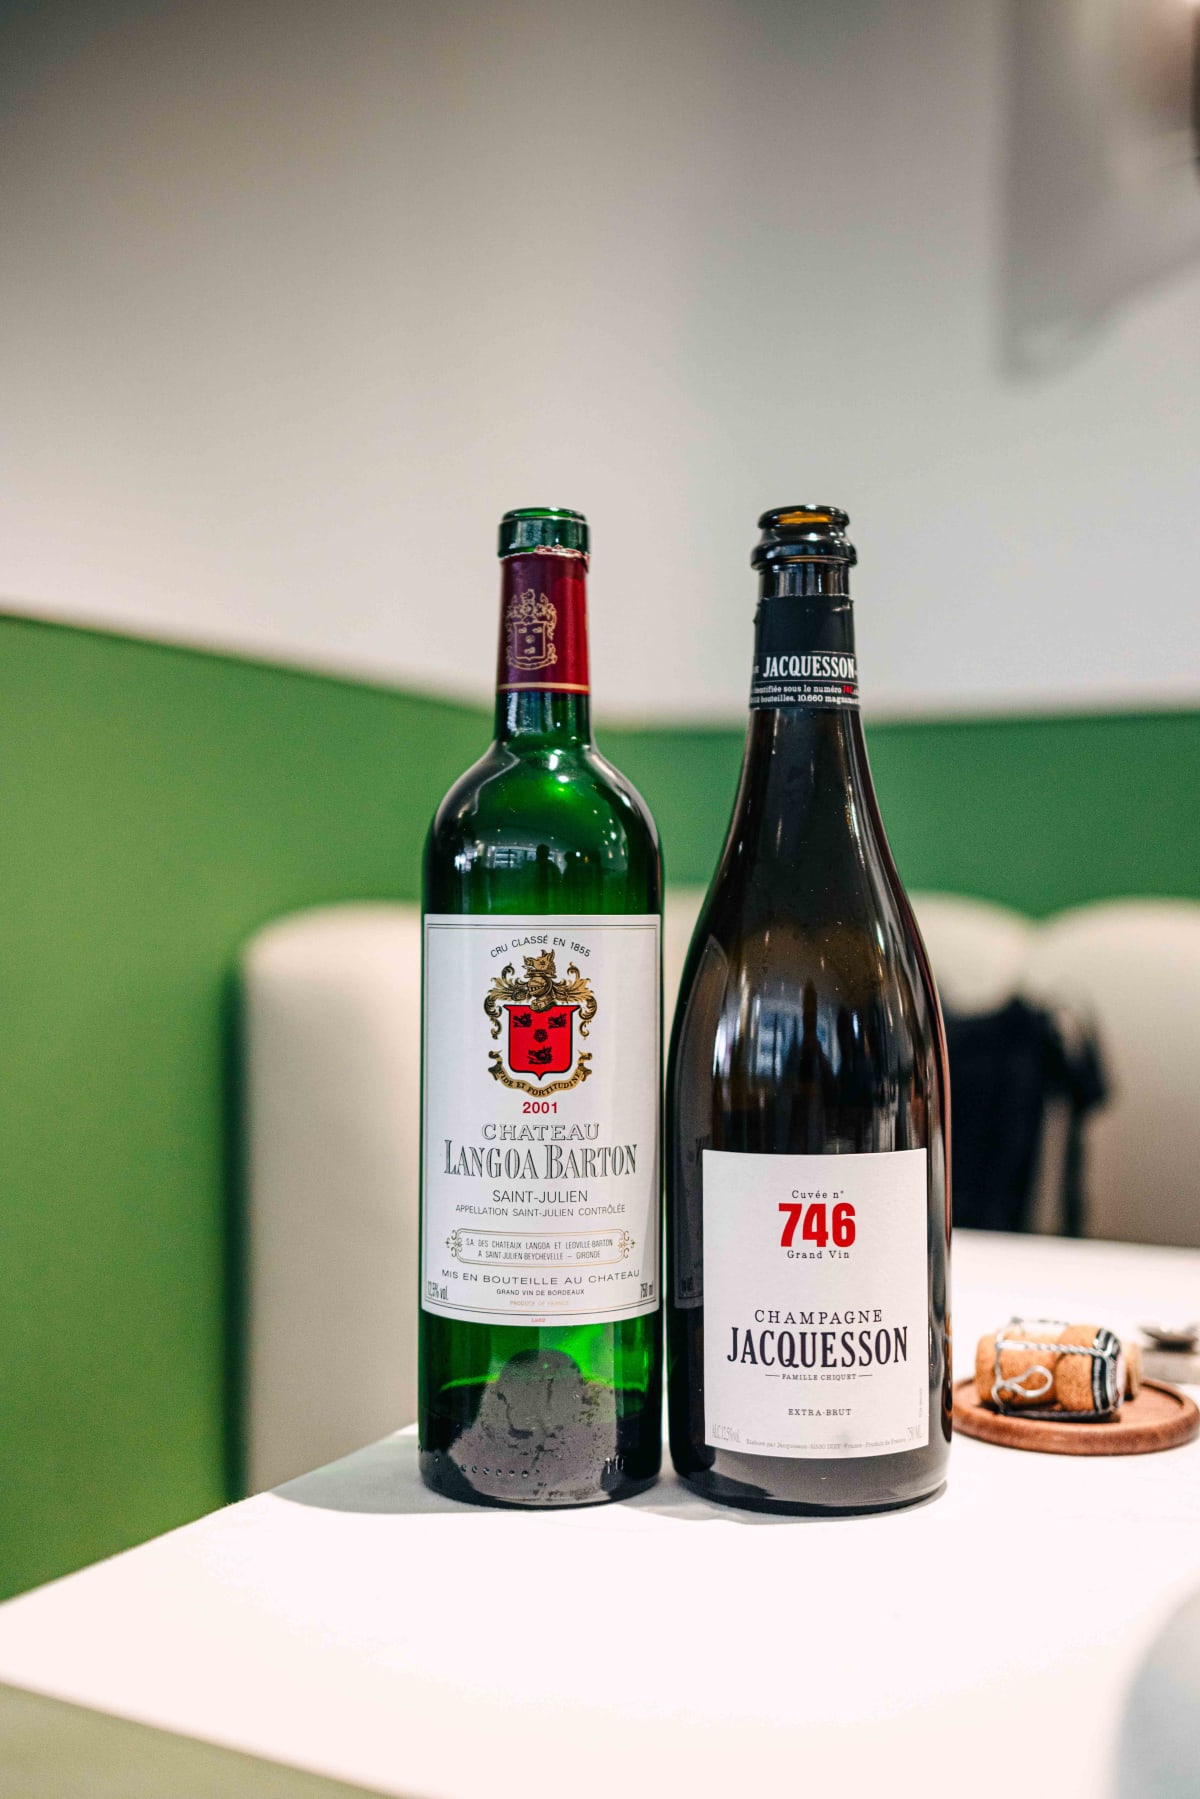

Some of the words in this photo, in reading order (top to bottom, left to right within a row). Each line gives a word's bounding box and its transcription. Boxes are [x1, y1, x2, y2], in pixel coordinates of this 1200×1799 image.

[763, 656, 855, 678] JACQUESSON
[804, 684, 811, 692] le
[814, 685, 842, 693] numéro
[490, 944, 508, 958] CRU
[512, 935, 548, 948] CLASSÉ
[553, 938, 566, 947] EN
[570, 942, 591, 957] 1855
[522, 1102, 558, 1114] 2001
[482, 1122, 600, 1140] CHATEAU
[444, 1139, 539, 1179] LANGOA
[544, 1144, 637, 1179] BARTON
[492, 1190, 588, 1203] SAINT-JULIEN
[792, 1190, 828, 1198] Cuvée
[456, 1204, 508, 1216] APPELLATION
[512, 1208, 574, 1217] SAINT-JULIEN
[578, 1204, 626, 1216] CONTRÔLÉE
[778, 1202, 856, 1248] 746
[492, 1241, 522, 1250] CHATEAUX
[554, 1242, 561, 1250] ET
[576, 1251, 600, 1260] GIRONDE
[787, 1250, 822, 1258] Grand
[829, 1250, 850, 1258] Vin
[442, 1269, 458, 1279] MIS
[462, 1272, 478, 1282] EN
[483, 1275, 558, 1285] BOUTEILLE
[564, 1277, 582, 1285] AU
[588, 1270, 640, 1284] CHATEAU
[496, 1288, 520, 1296] GRAND
[754, 1310, 882, 1324] CHAMPAGNE
[727, 1326, 908, 1368] JACQUESSON
